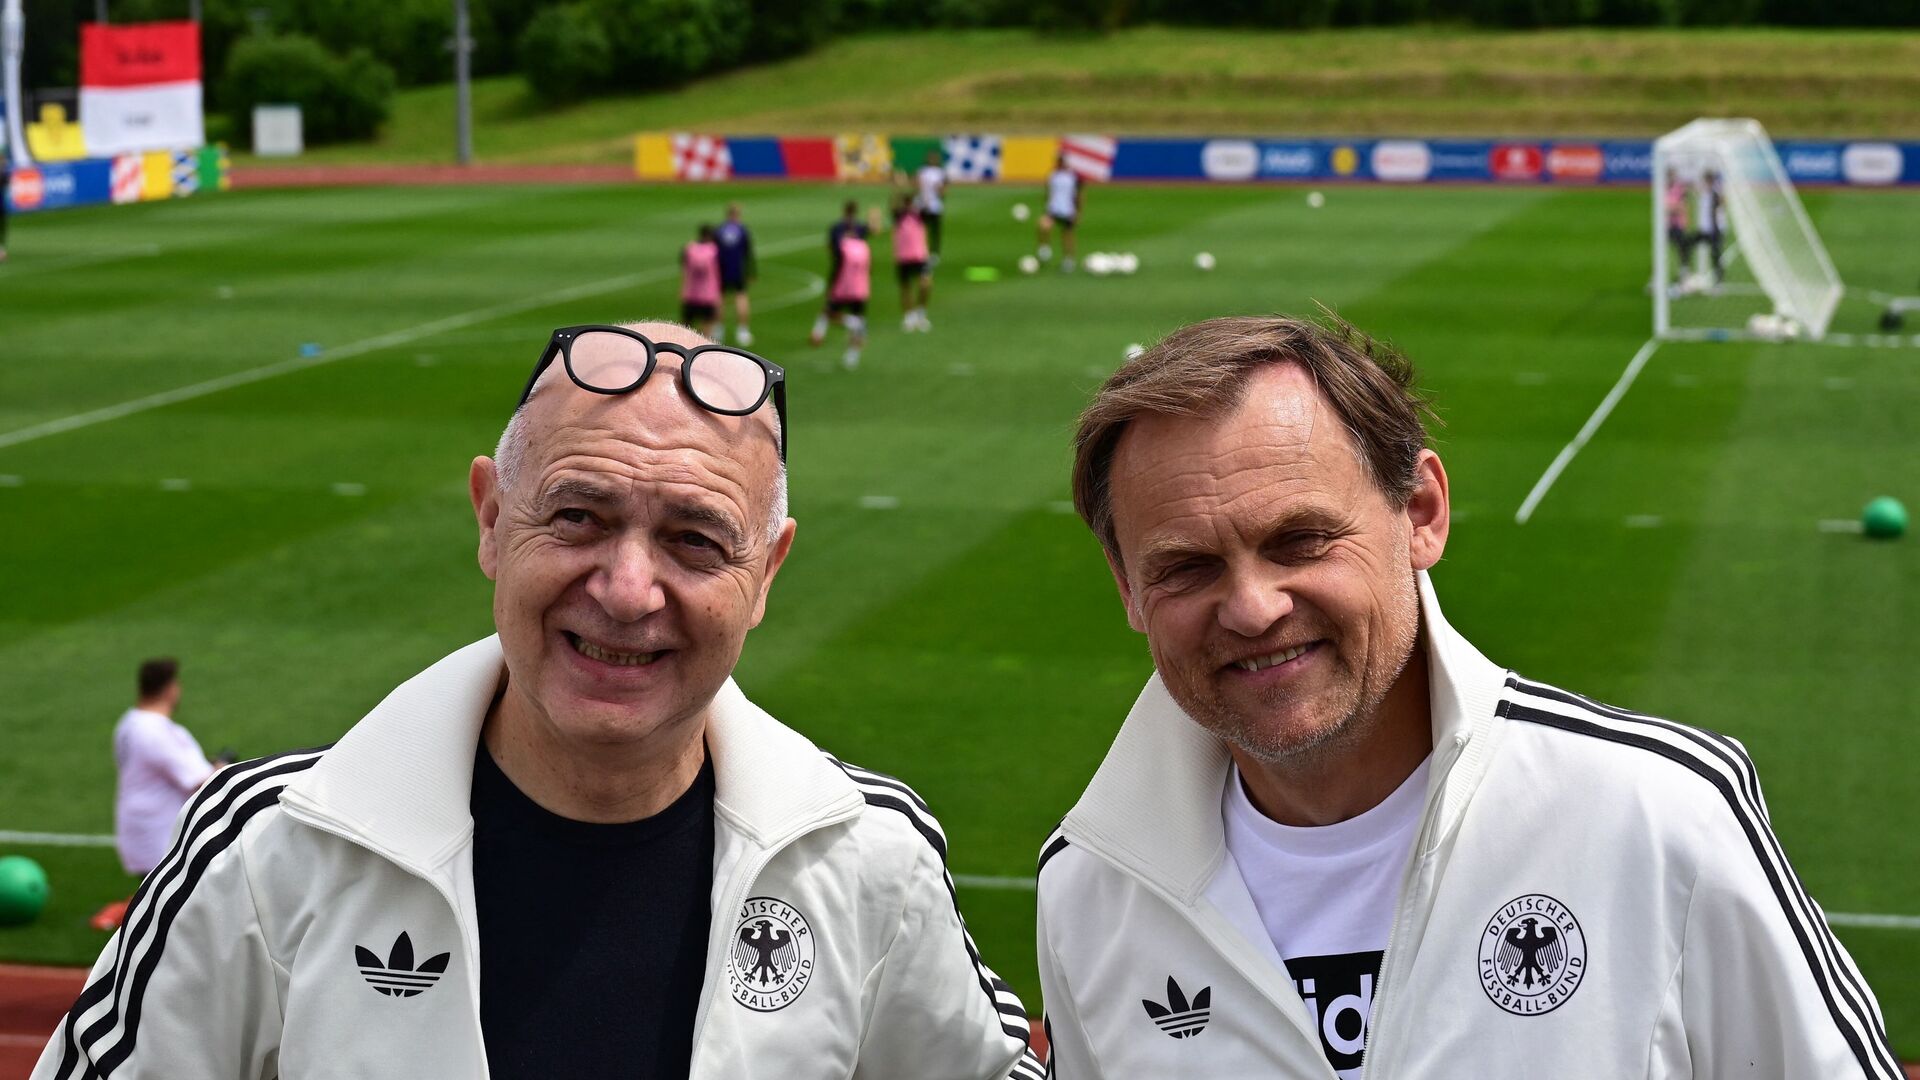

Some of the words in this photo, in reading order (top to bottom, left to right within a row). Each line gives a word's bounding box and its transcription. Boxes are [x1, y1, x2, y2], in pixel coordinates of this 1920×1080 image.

[738, 901, 807, 938] UTSCHER
[1488, 898, 1575, 936] DEUTSCHER
[727, 959, 811, 1008] SSBALL-BUND
[1482, 957, 1582, 1012] FUSSBALL-BUND
